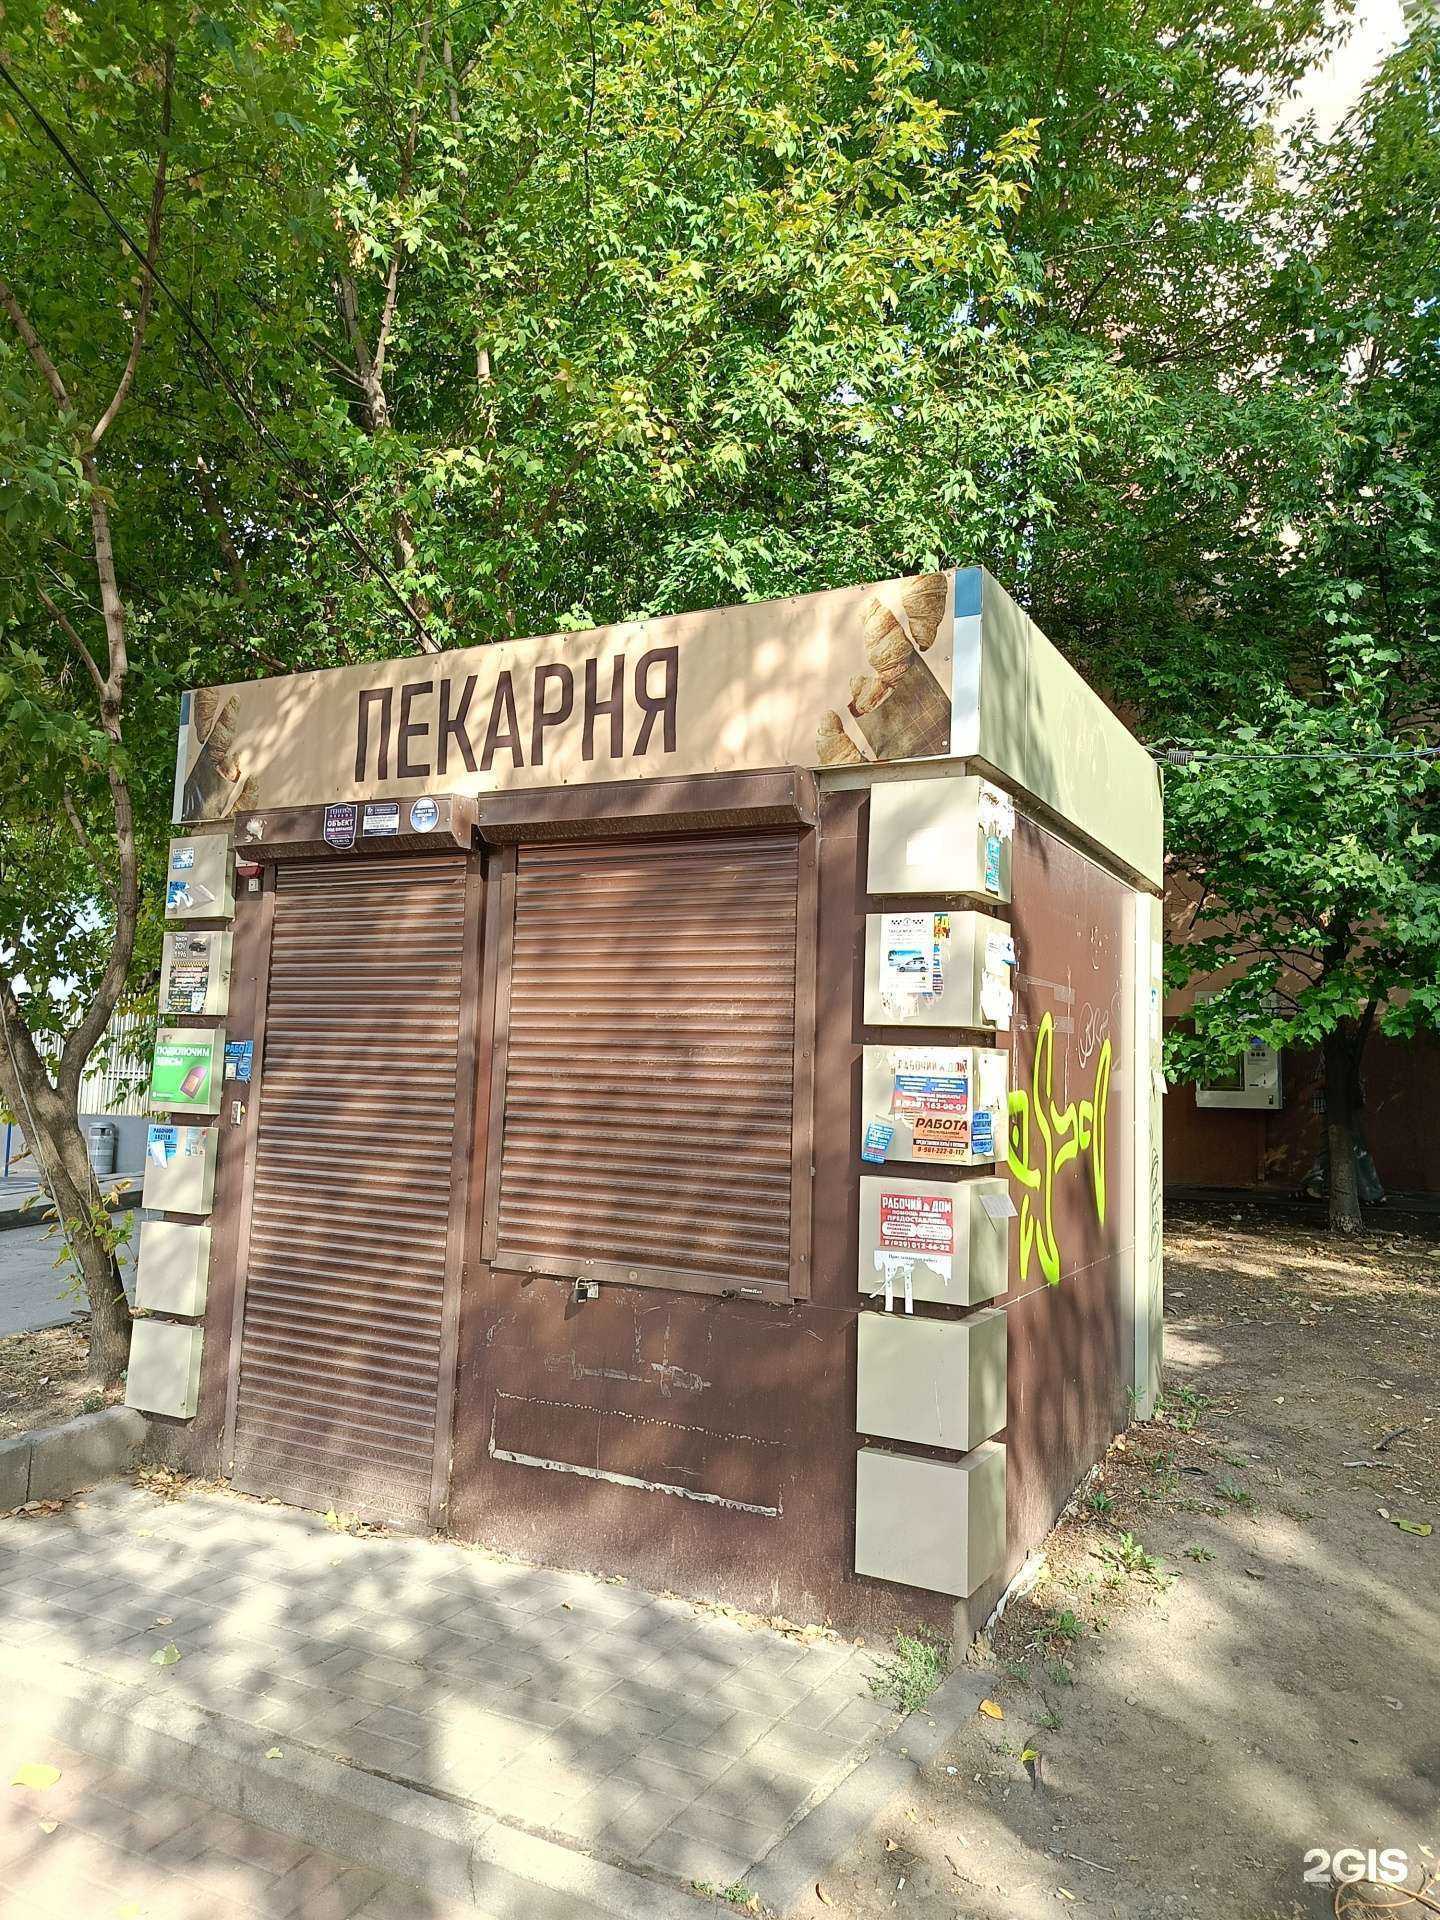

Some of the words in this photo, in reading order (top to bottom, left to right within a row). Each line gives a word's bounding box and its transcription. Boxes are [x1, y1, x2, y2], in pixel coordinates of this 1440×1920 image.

[355, 645, 679, 783] ПЕКАРНЯ
[915, 1117, 968, 1131] РАБОТА
[882, 1196, 922, 1210] РАБОЧИЙ
[932, 1200, 951, 1213] ДОМ
